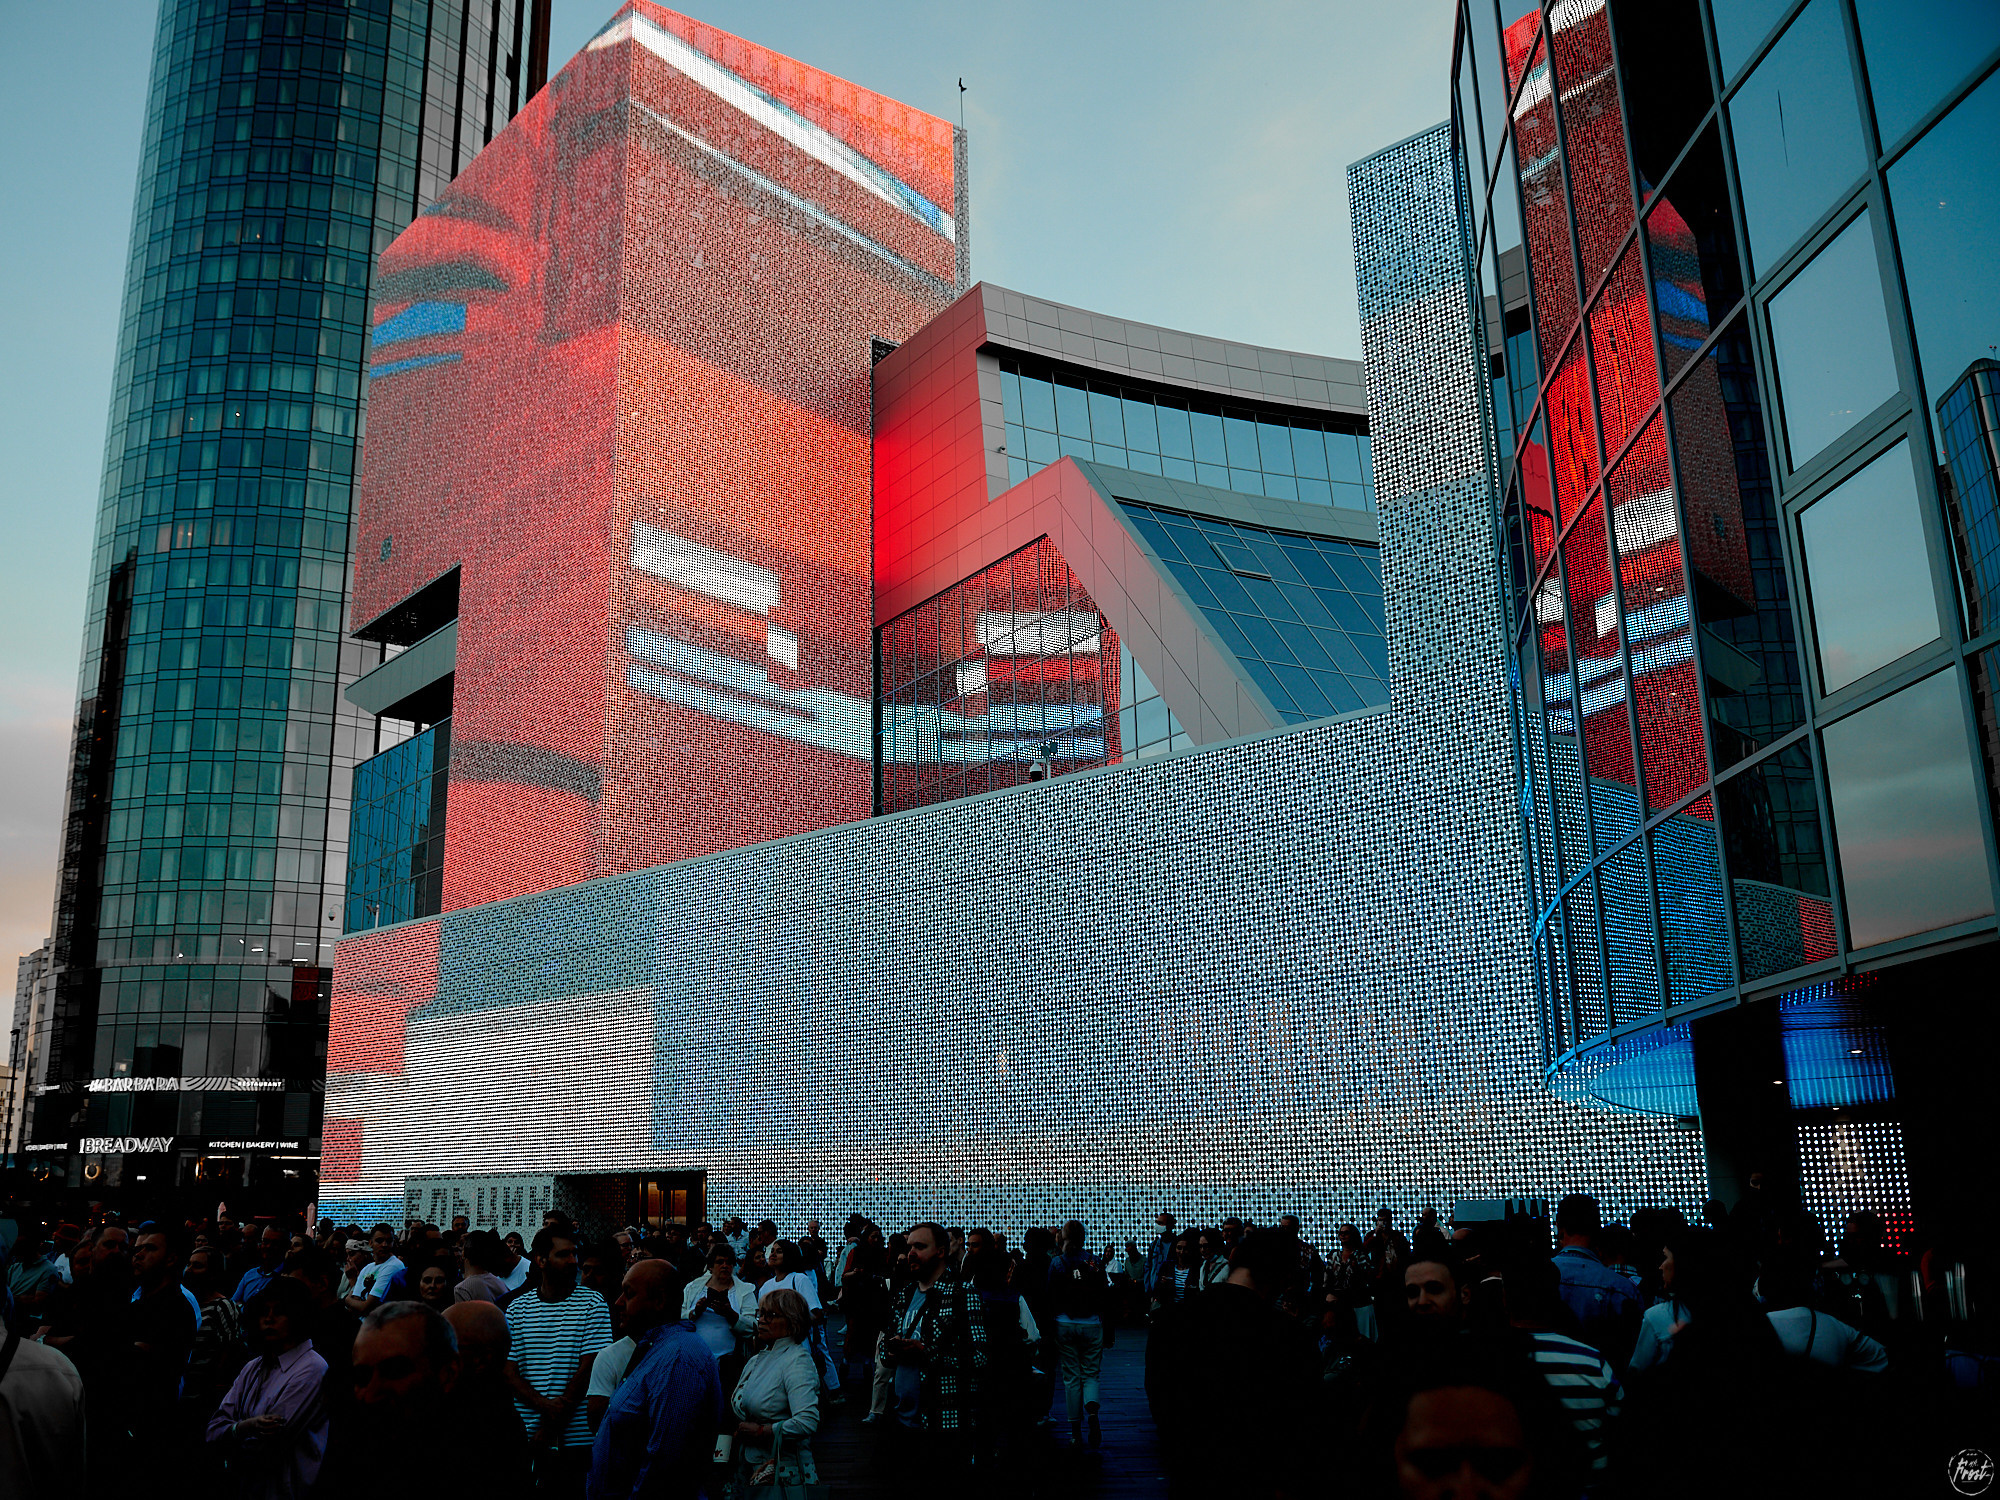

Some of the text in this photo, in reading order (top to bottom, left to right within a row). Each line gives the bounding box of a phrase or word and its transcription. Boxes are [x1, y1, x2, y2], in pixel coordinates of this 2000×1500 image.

[208, 1141, 299, 1149] KITCHEN BAKERY WINE
